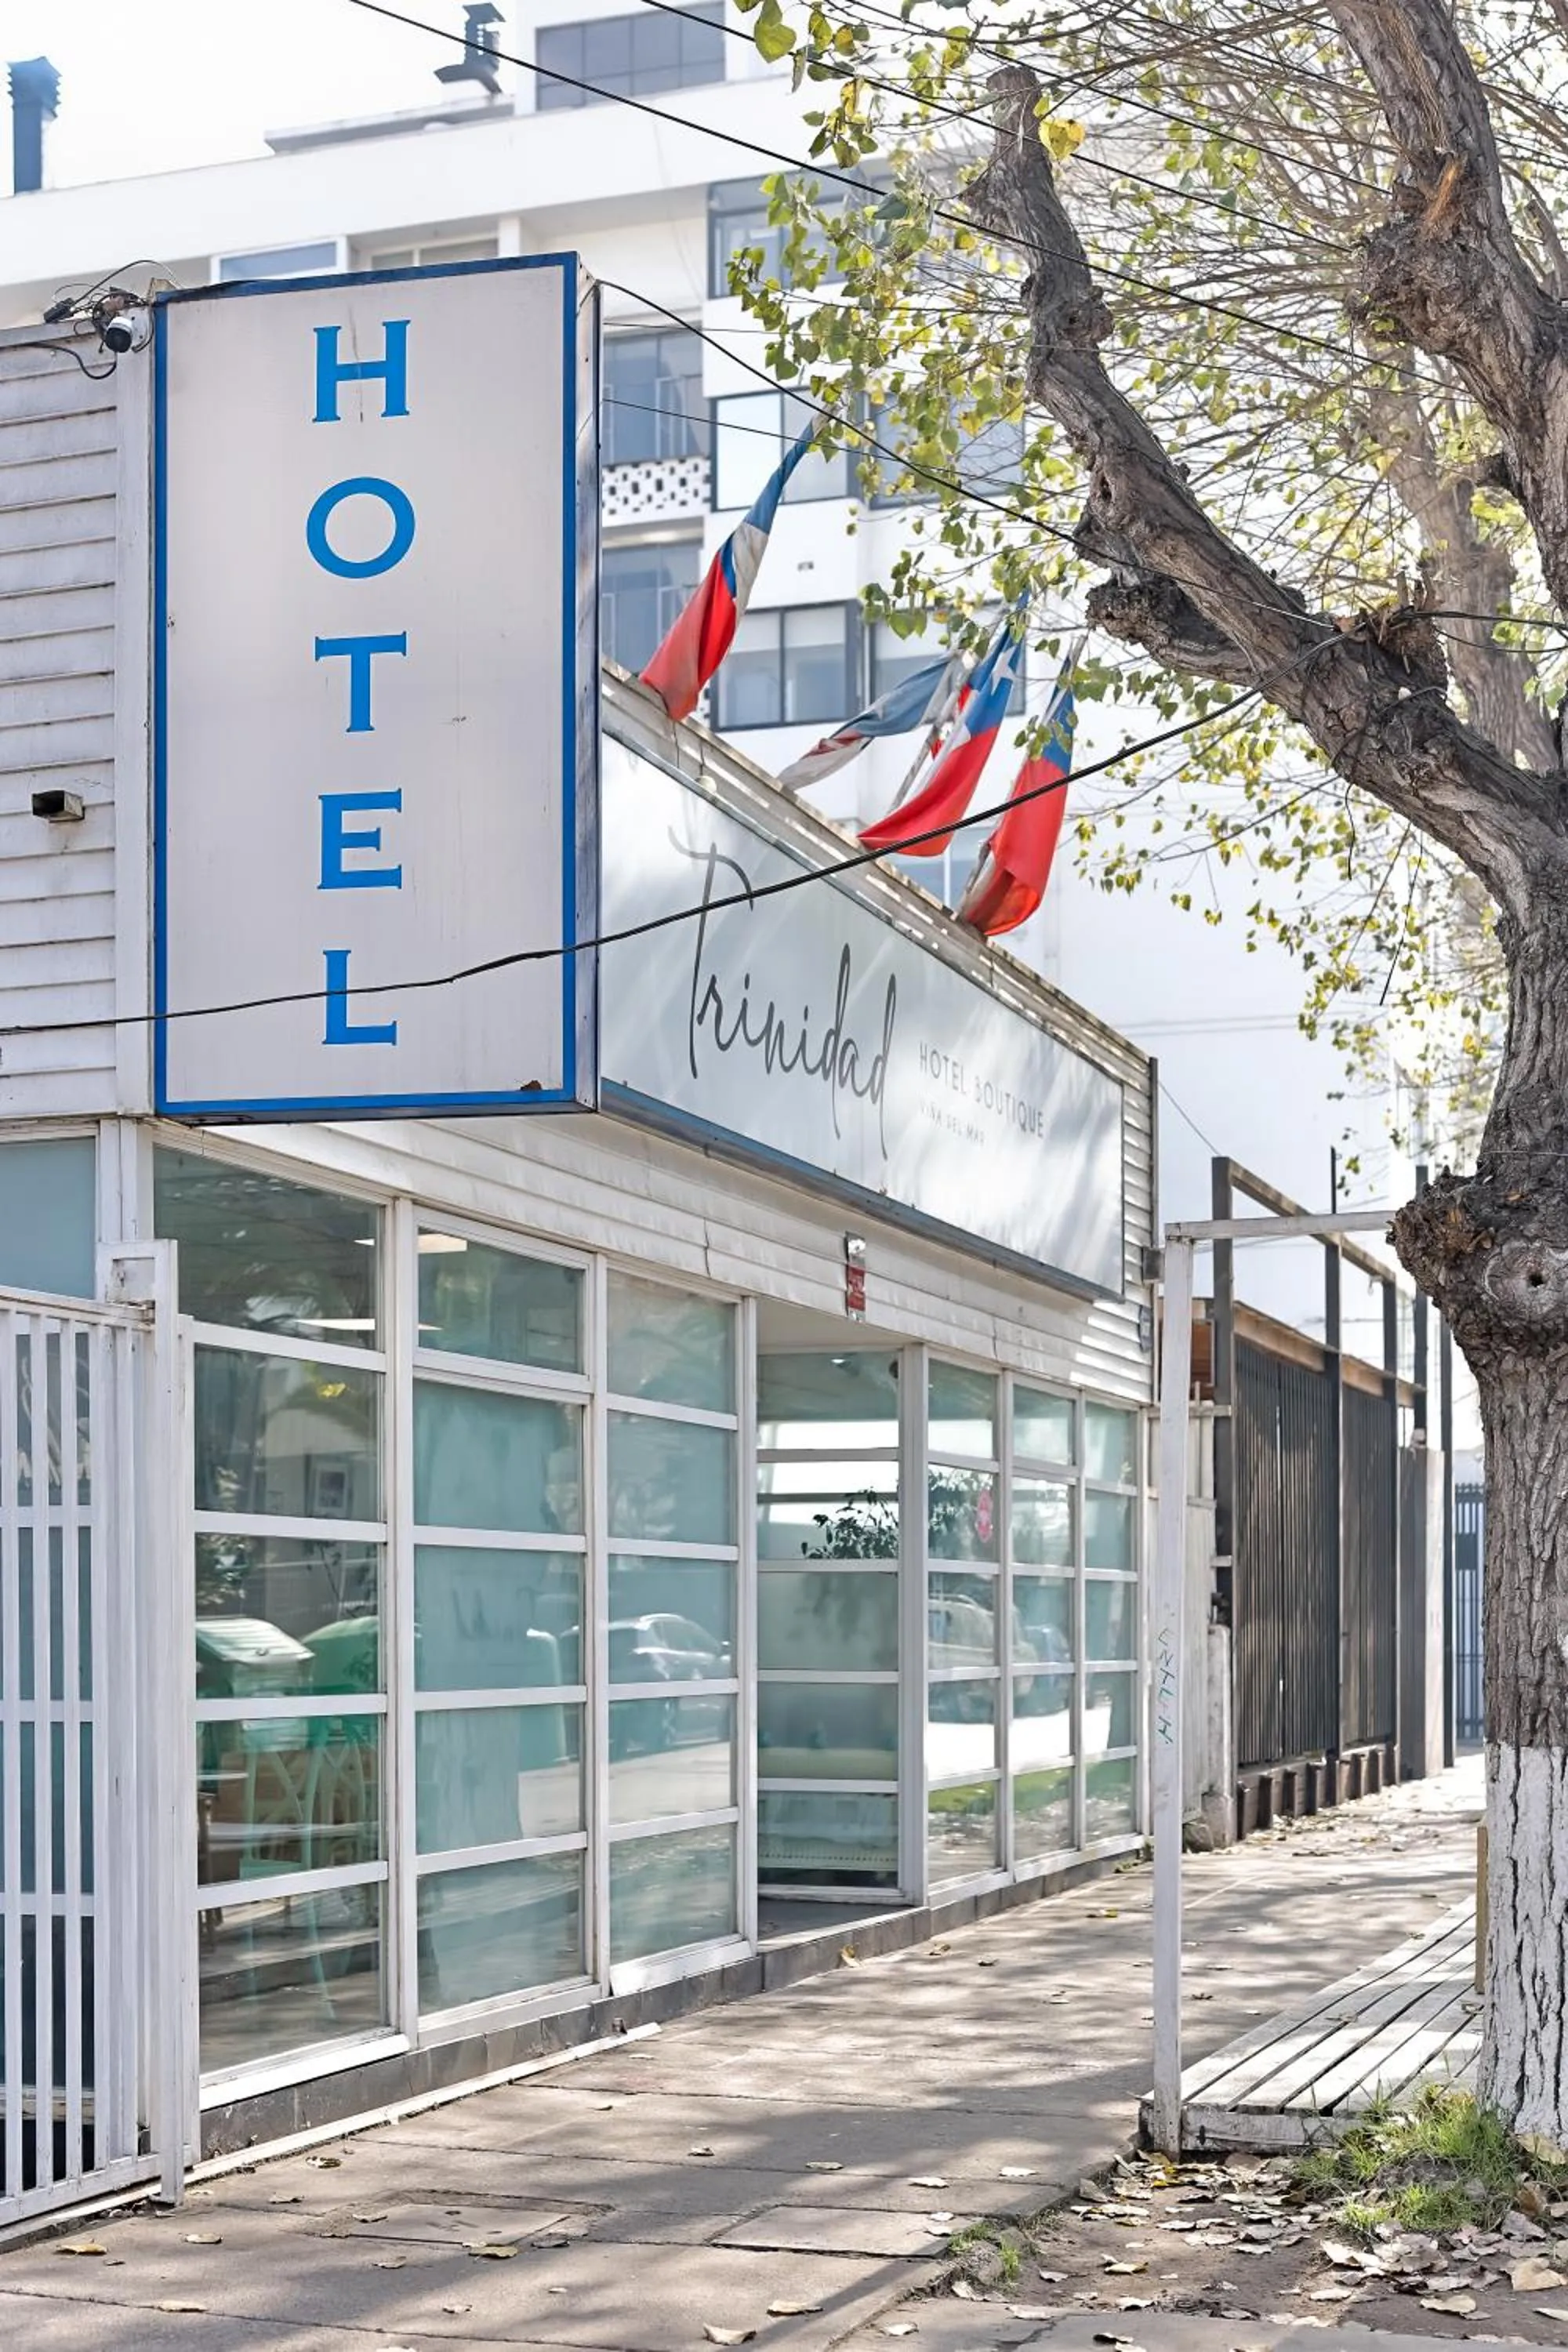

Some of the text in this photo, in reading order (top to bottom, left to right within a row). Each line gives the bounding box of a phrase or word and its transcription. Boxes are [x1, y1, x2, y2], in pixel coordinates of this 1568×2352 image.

[306, 319, 416, 1046] HOTEL
[667, 825, 897, 1160] Trinidad
[919, 1041, 966, 1095] HOTEL
